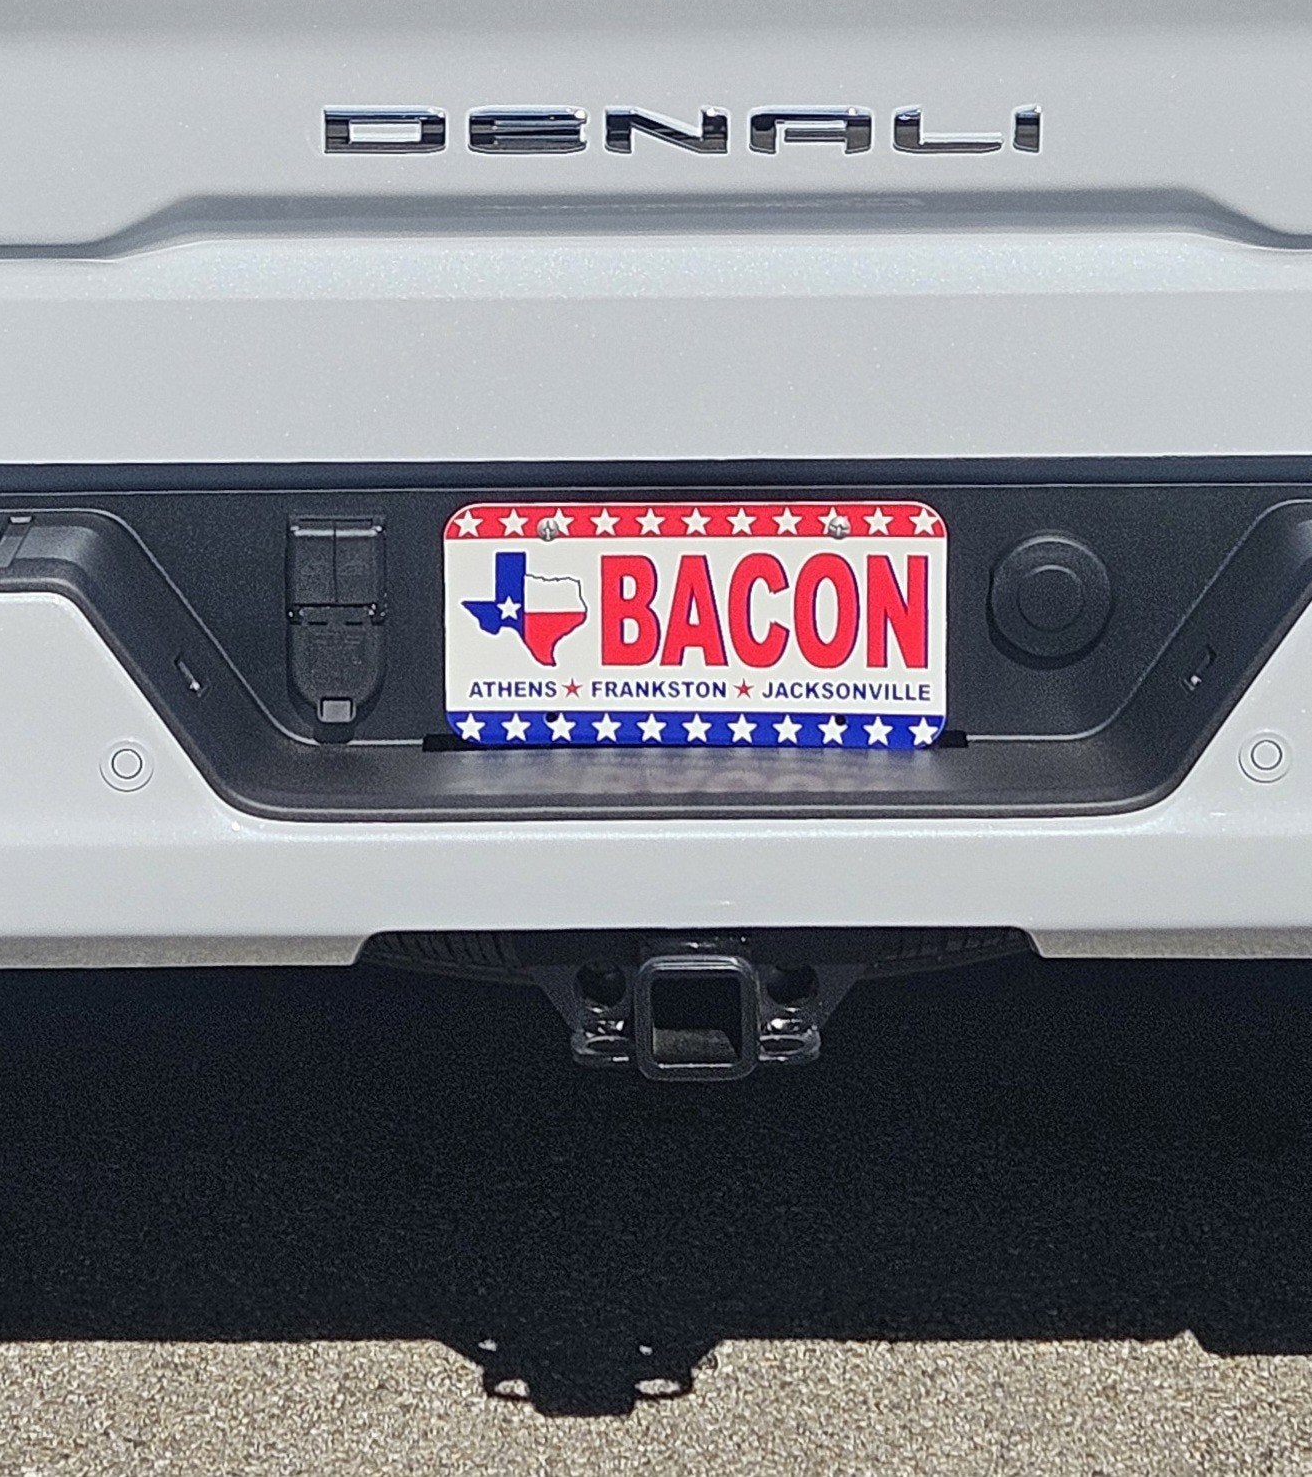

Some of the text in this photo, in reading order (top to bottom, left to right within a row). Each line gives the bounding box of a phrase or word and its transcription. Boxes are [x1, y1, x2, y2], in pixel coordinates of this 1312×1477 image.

[323, 106, 1042, 154] DENALI
[600, 553, 929, 669] BACON
[468, 680, 932, 702] ATHENS FRANKSTON JACKSONVILLE
